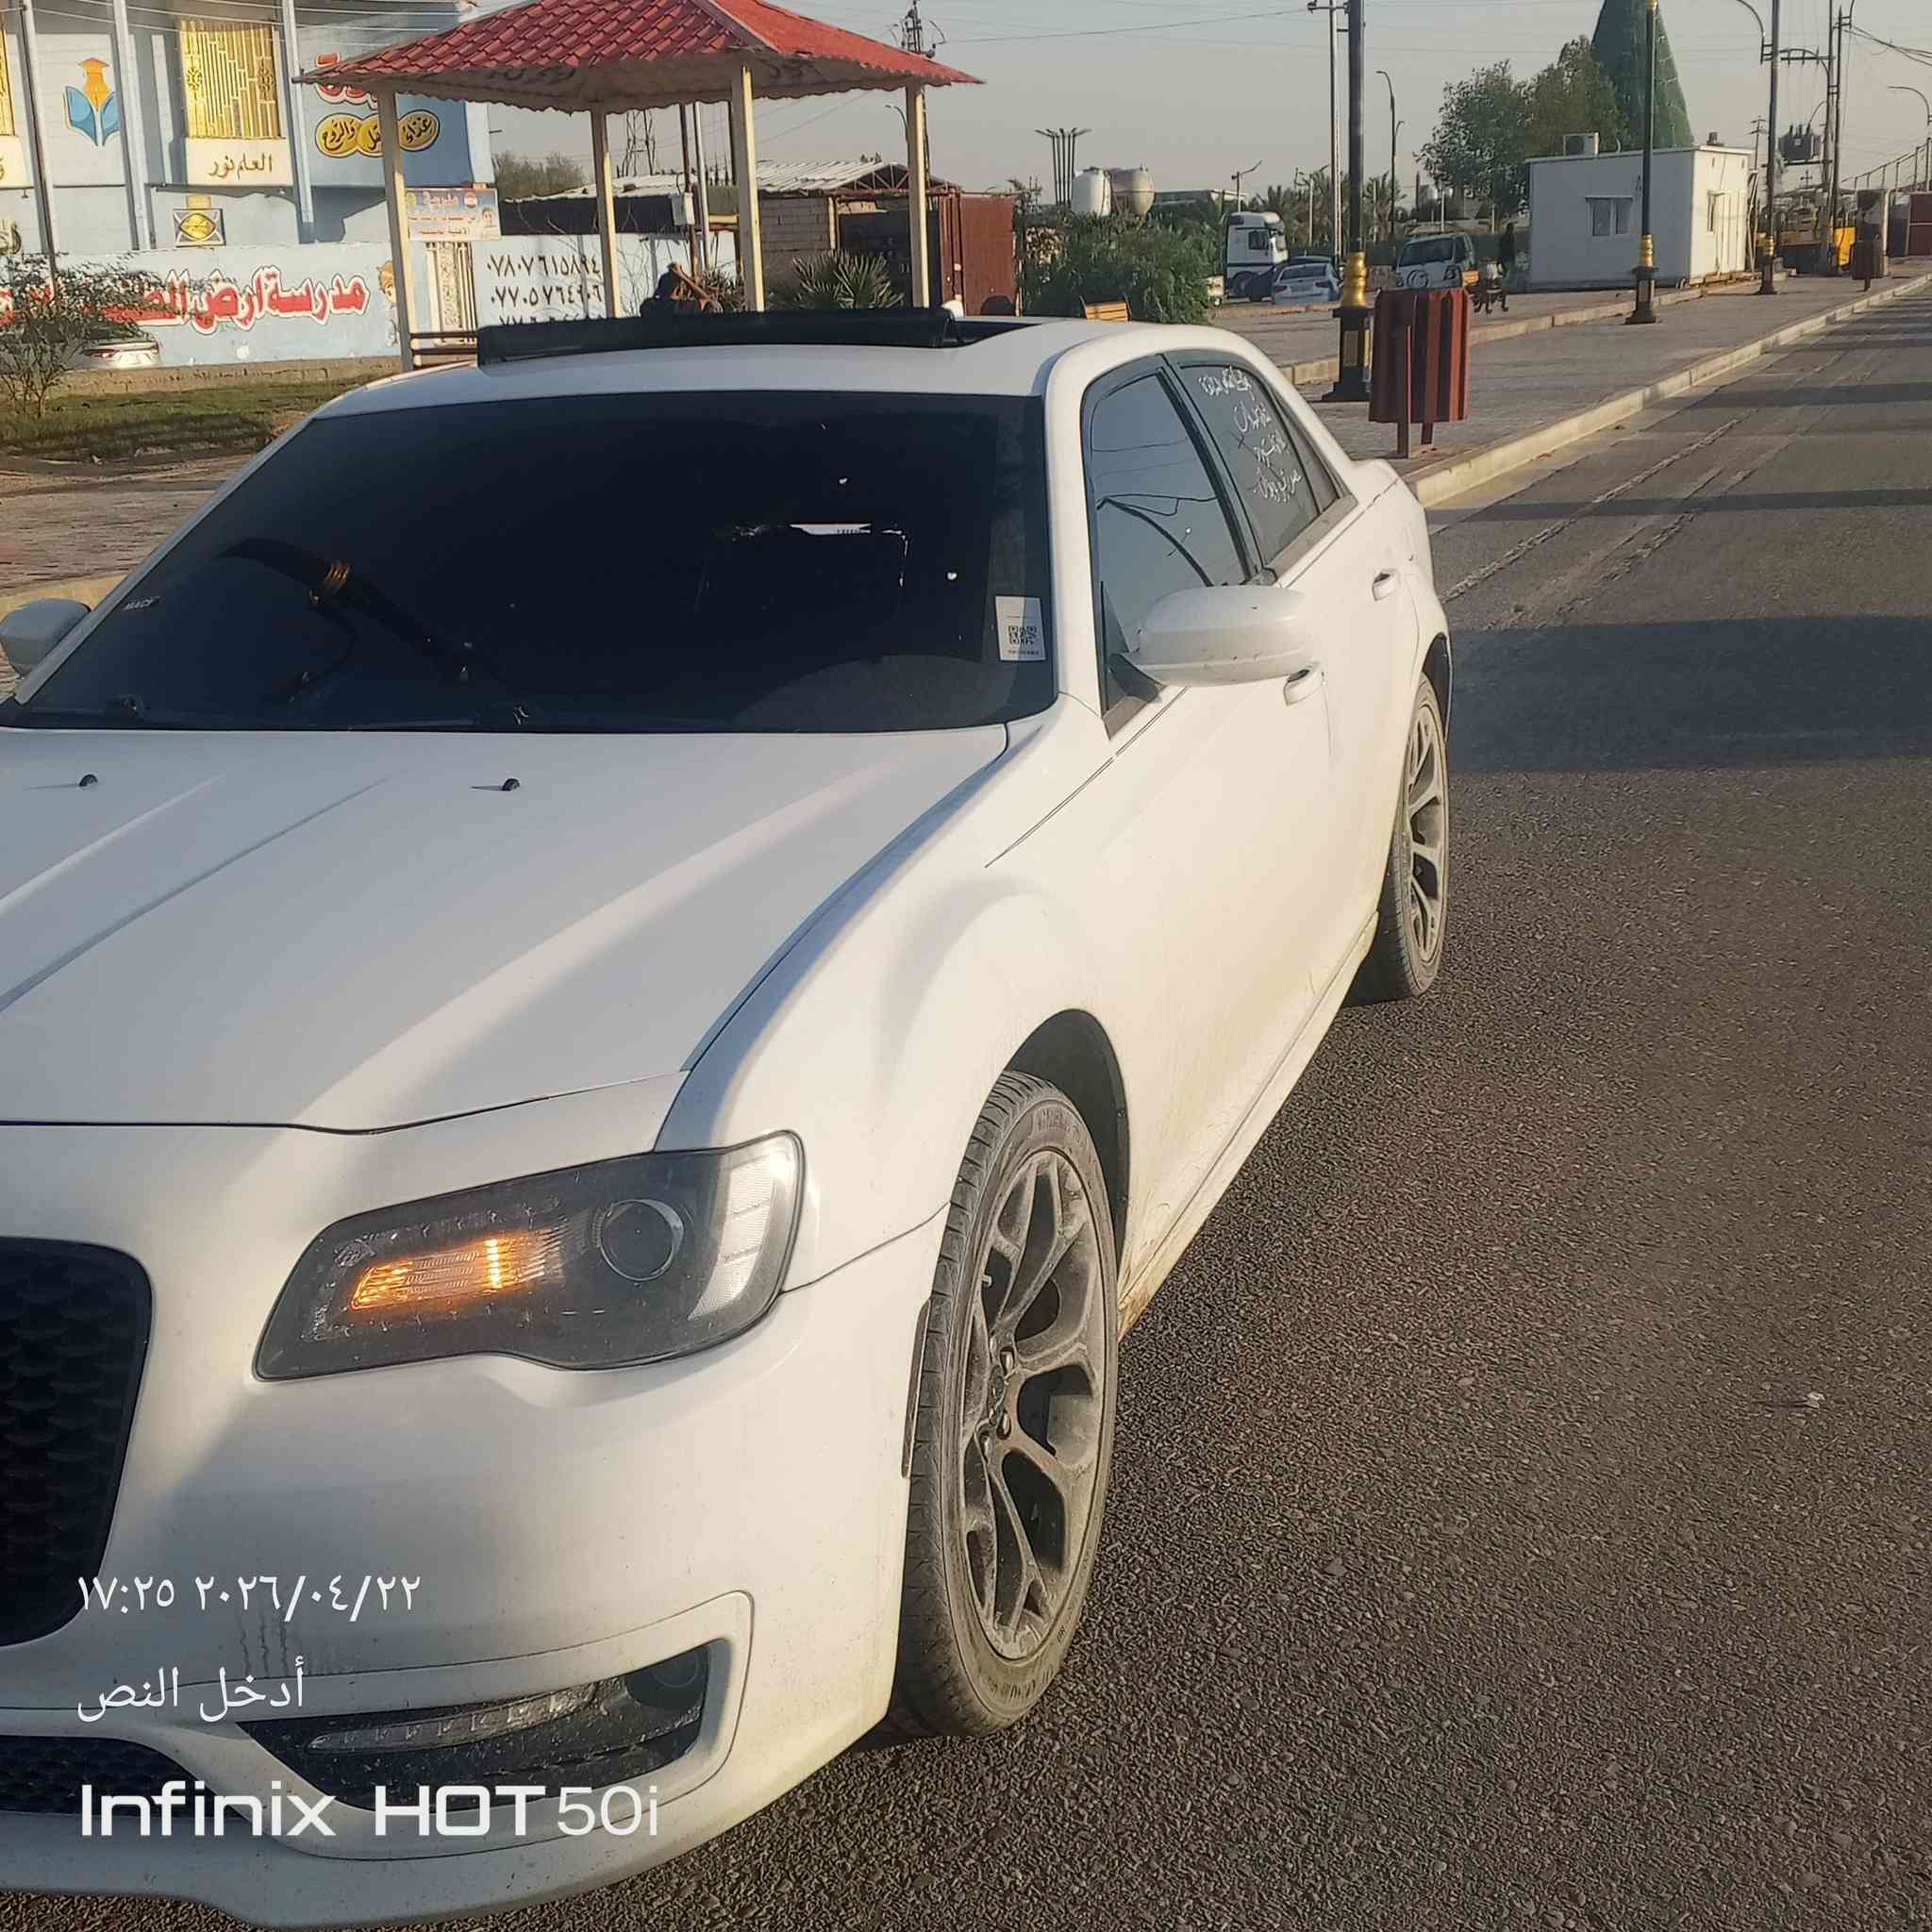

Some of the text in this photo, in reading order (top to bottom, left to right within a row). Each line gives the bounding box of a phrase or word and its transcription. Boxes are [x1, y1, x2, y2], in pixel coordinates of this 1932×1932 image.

[208, 152, 273, 180] العلم نور
[266, 264, 370, 325] مدرسة
